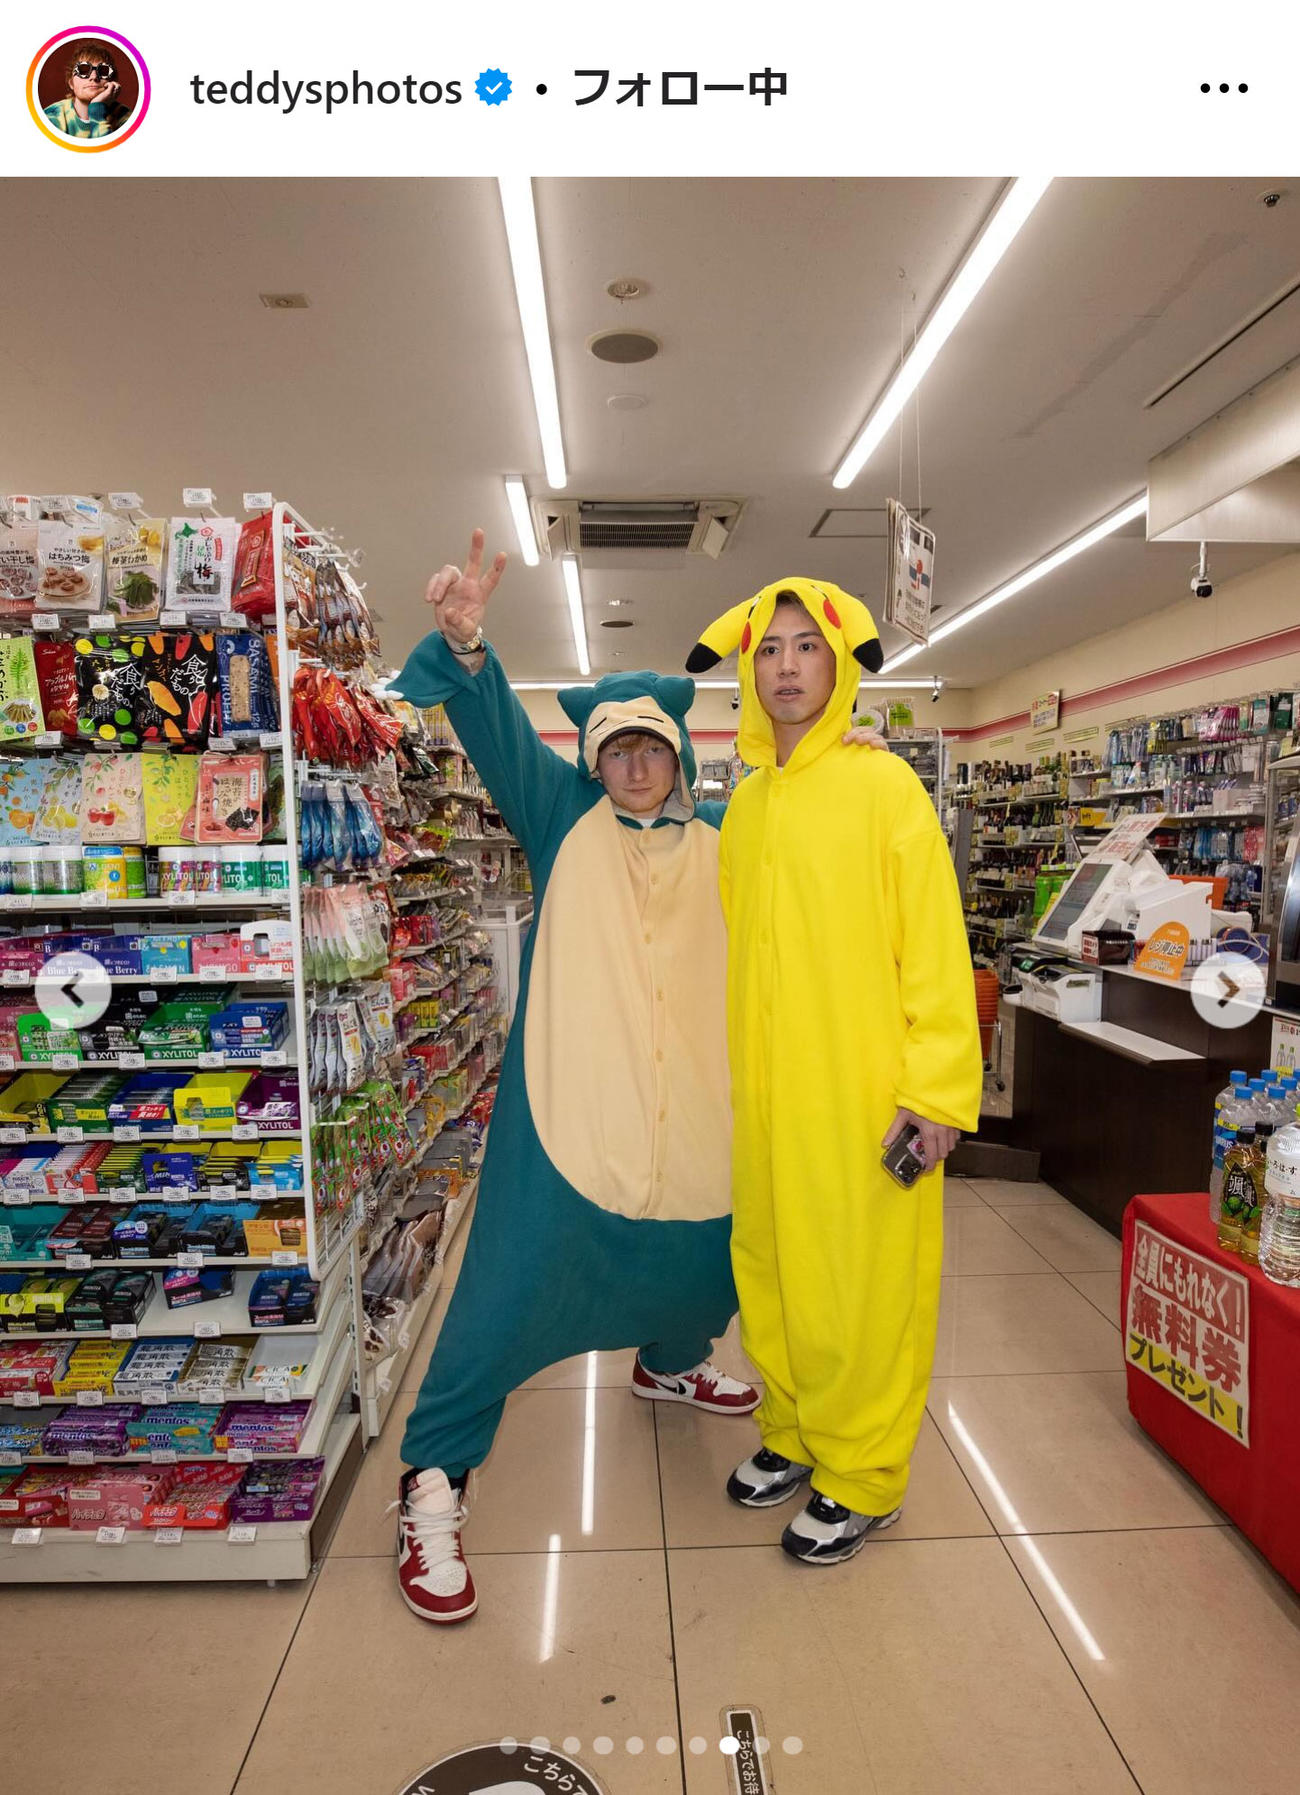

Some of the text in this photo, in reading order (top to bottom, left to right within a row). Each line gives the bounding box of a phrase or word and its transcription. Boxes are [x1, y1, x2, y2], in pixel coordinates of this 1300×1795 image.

[48, 552, 90, 564] はちみつ梅
[194, 562, 213, 580] 梅
[1148, 940, 1185, 957] レジ停止中
[116, 966, 138, 976] Berry
[162, 1049, 197, 1058] XYLITOL
[1131, 1283, 1242, 1393] 無料券
[118, 1372, 154, 1380] 龍角散
[146, 1417, 191, 1425] mentos
[231, 1424, 275, 1432] mentos
[71, 1508, 106, 1521] ハイチュウ
